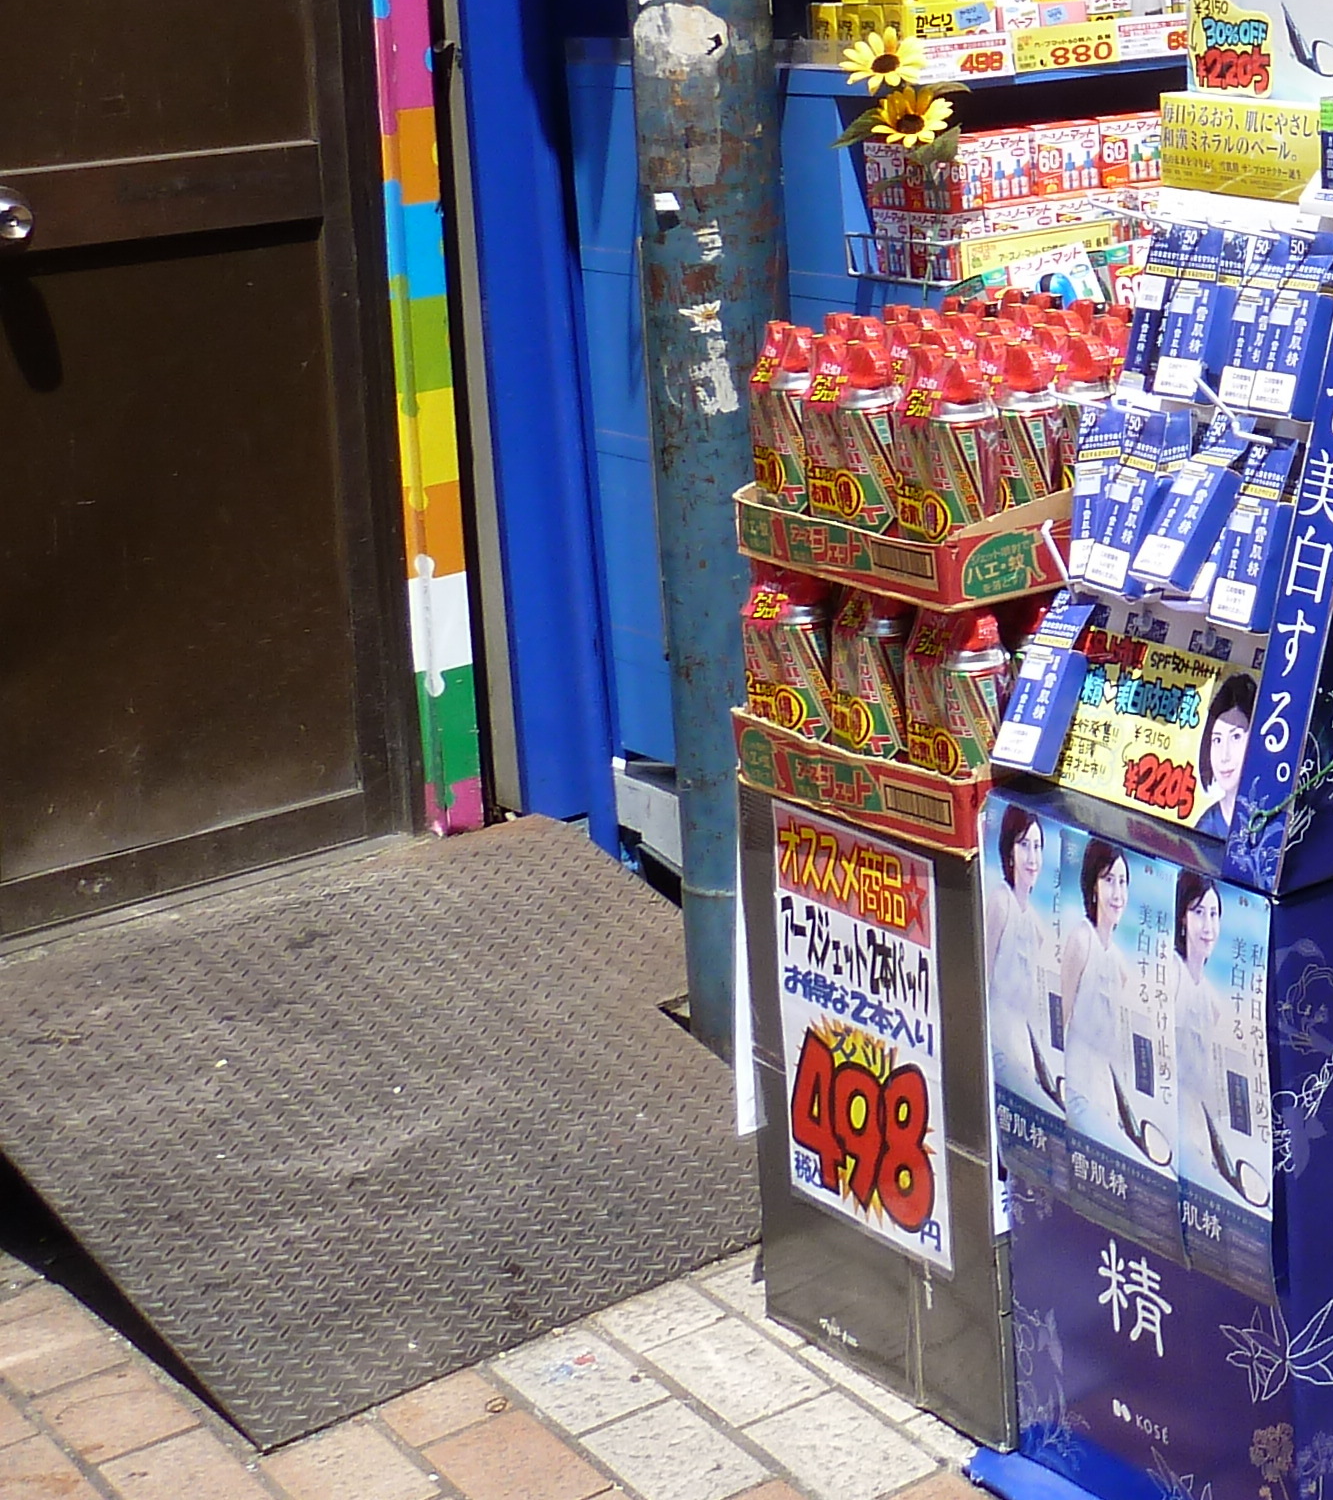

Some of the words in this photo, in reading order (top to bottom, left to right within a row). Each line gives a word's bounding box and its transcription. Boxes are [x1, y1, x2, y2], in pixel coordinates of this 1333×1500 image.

[1049, 41, 1114, 67] 880
[790, 1028, 935, 1234] 498
[1097, 1237, 1174, 1358] 精
